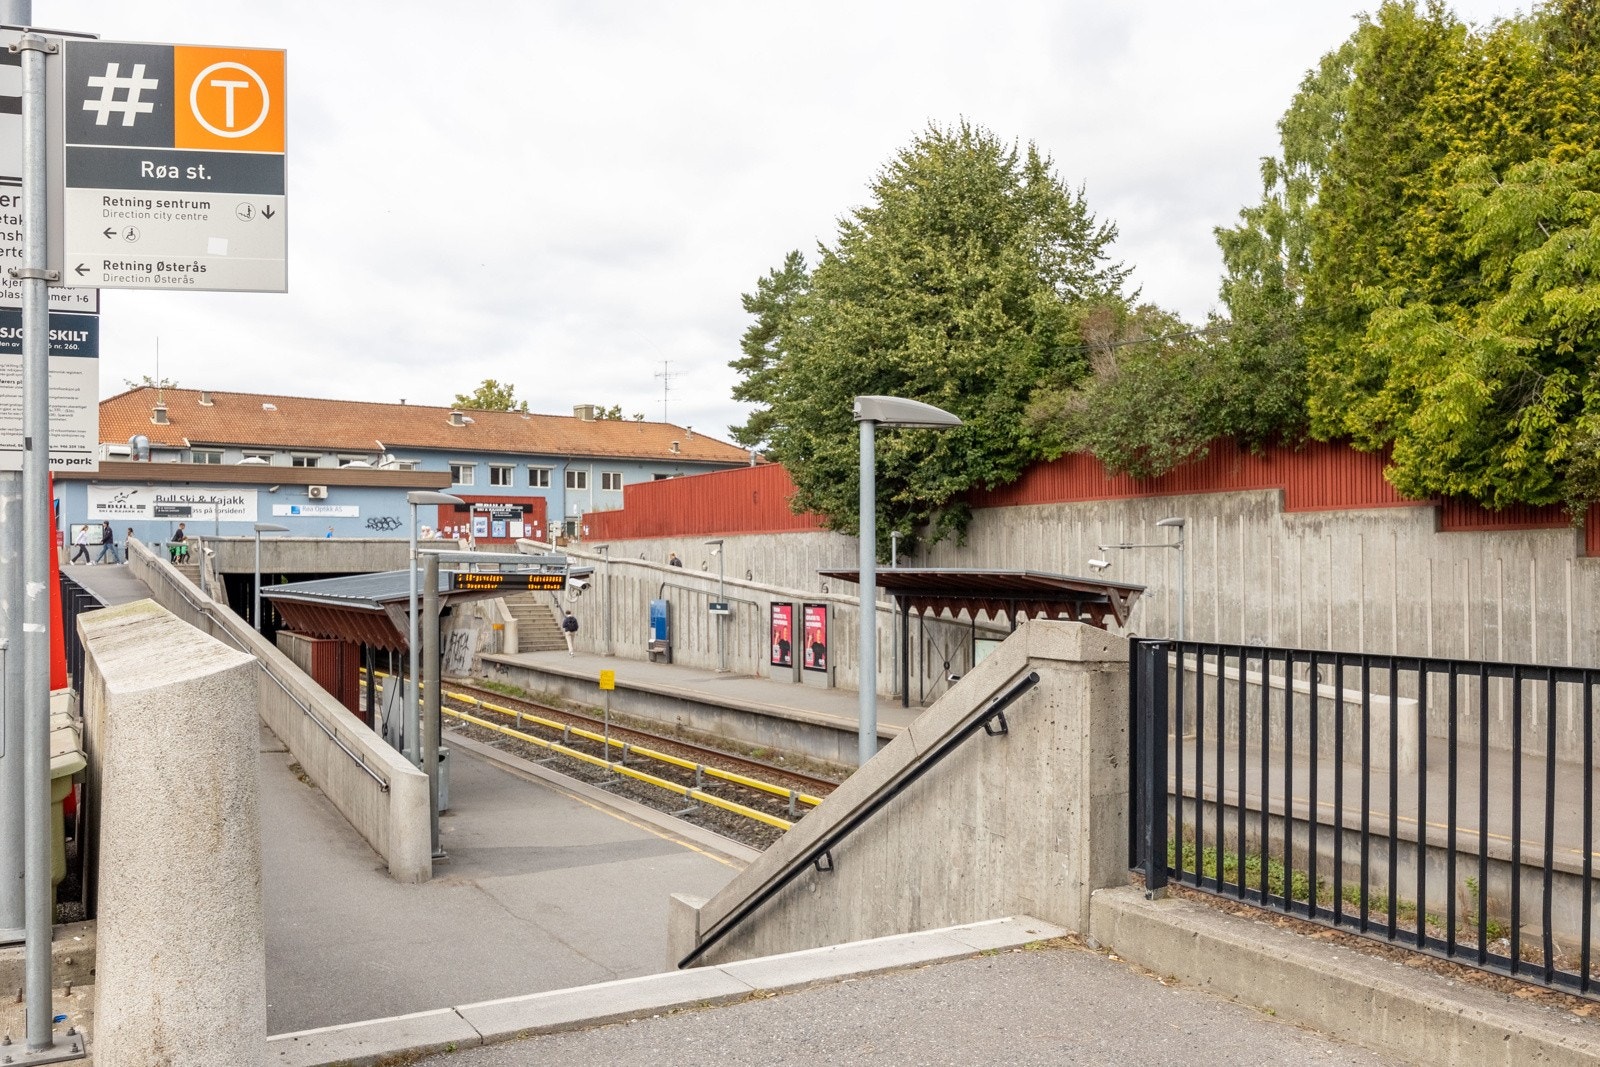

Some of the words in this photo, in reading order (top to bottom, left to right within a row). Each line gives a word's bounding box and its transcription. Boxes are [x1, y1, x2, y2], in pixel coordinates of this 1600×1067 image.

[210, 79, 249, 128] T
[141, 160, 179, 179] Røa
[186, 164, 212, 180] st.
[103, 195, 152, 209] Retning
[156, 199, 211, 210] sentrum
[103, 209, 151, 219] Direction
[154, 210, 173, 222] city
[175, 212, 209, 221] centre
[103, 260, 152, 274] Retning
[157, 260, 207, 273] Østerås
[103, 273, 151, 283] Direction
[154, 274, 195, 284] Østerås
[76, 294, 89, 303] 1-6
[66, 457, 92, 466] park
[210, 495, 245, 506] Kajakk
